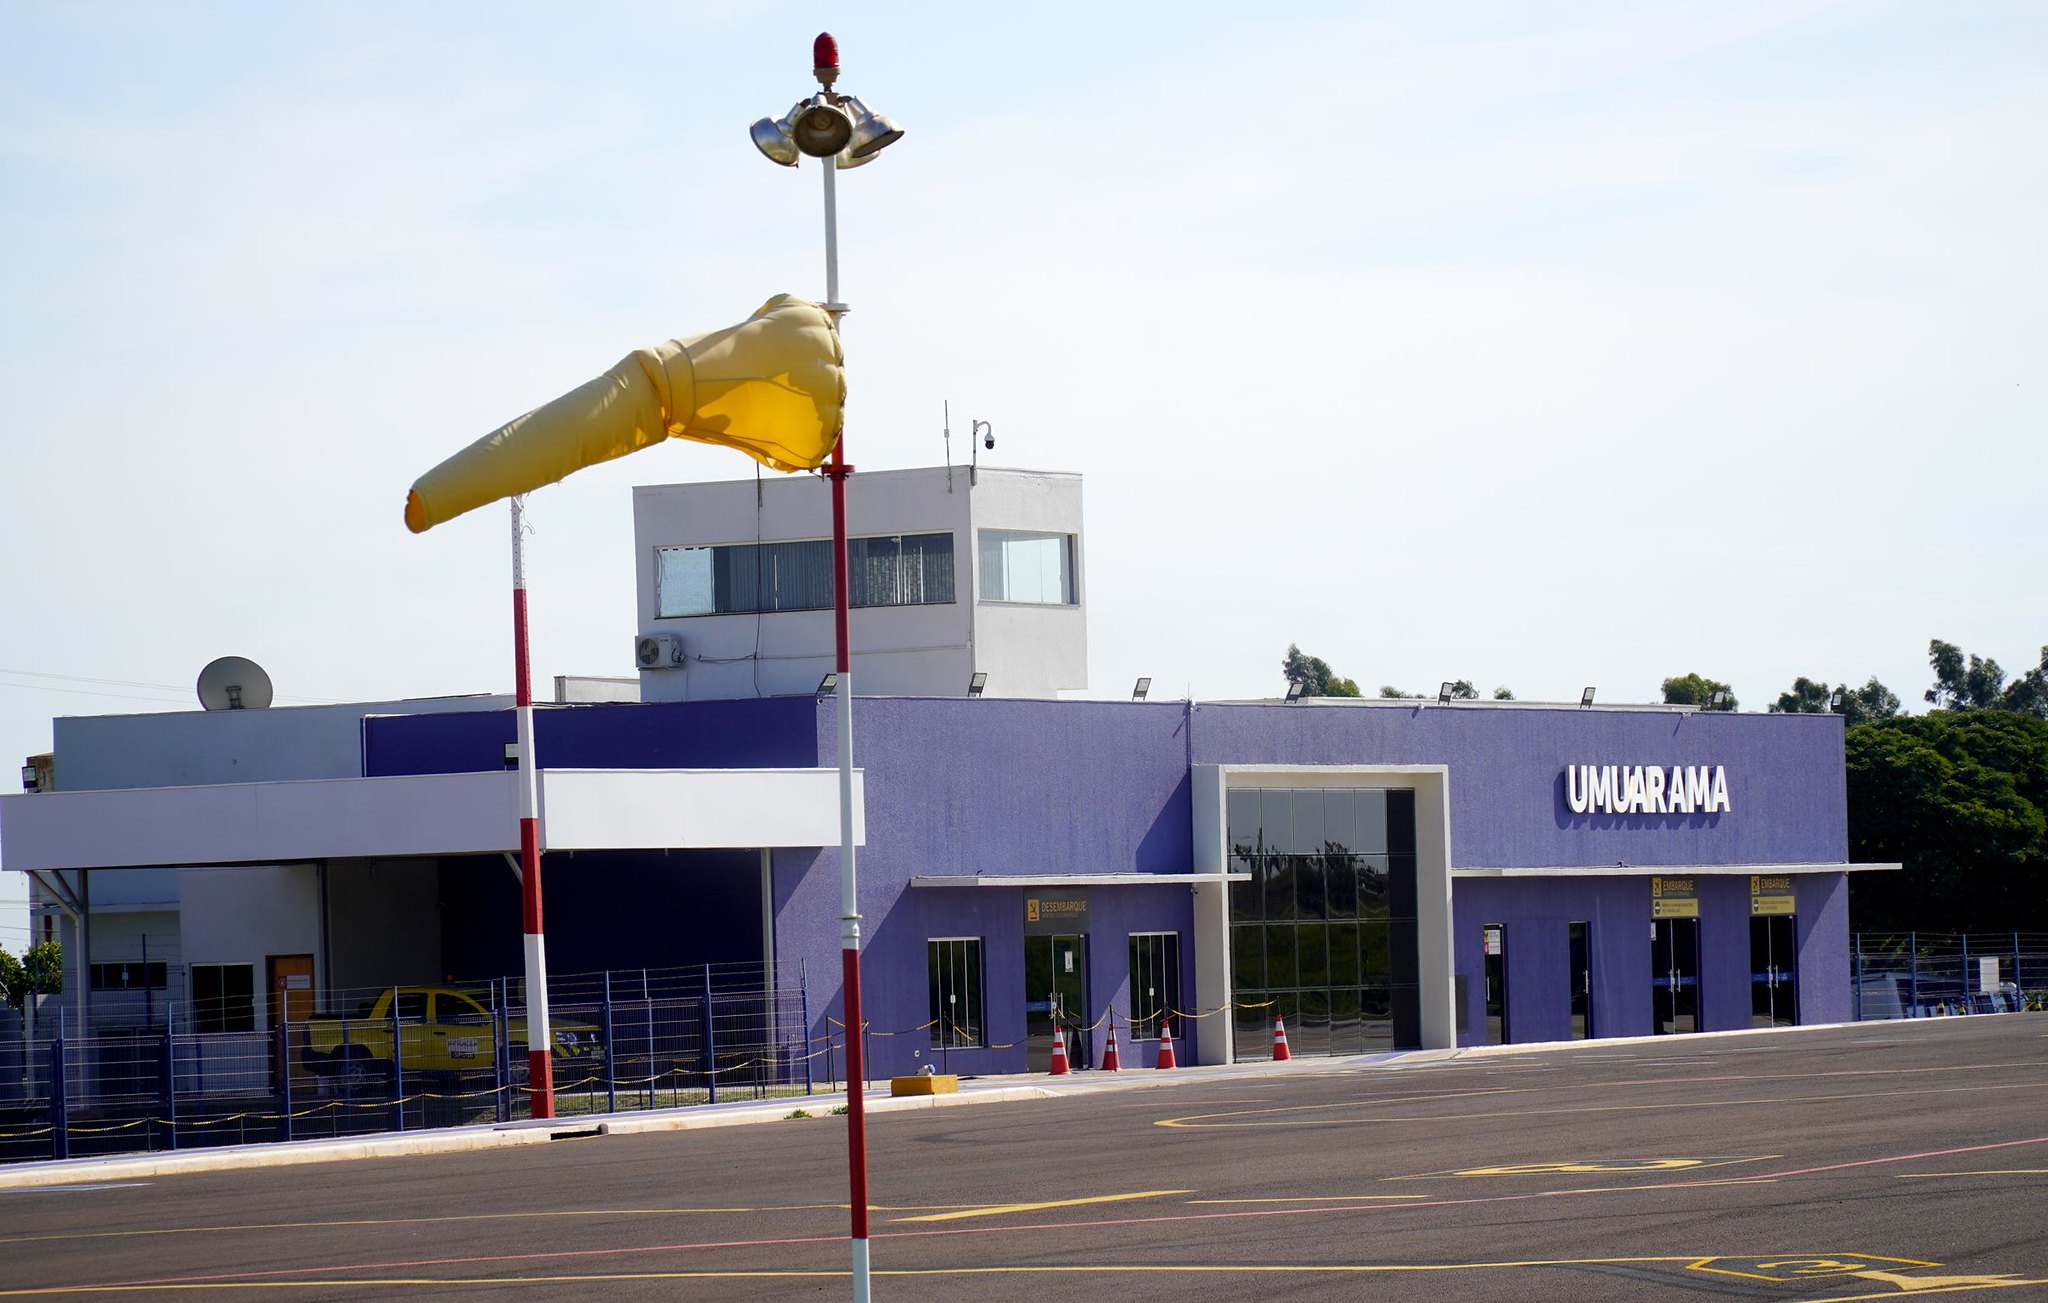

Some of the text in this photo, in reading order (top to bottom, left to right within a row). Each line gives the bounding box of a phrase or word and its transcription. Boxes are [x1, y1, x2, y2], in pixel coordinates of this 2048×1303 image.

[1567, 764, 1731, 814] UMUARAMA
[1663, 880, 1694, 891] EMBARQUE
[1761, 878, 1791, 889] EMBARQUE
[1041, 901, 1087, 913] DESEMBARQUE
[1757, 1259, 1866, 1274] 3
